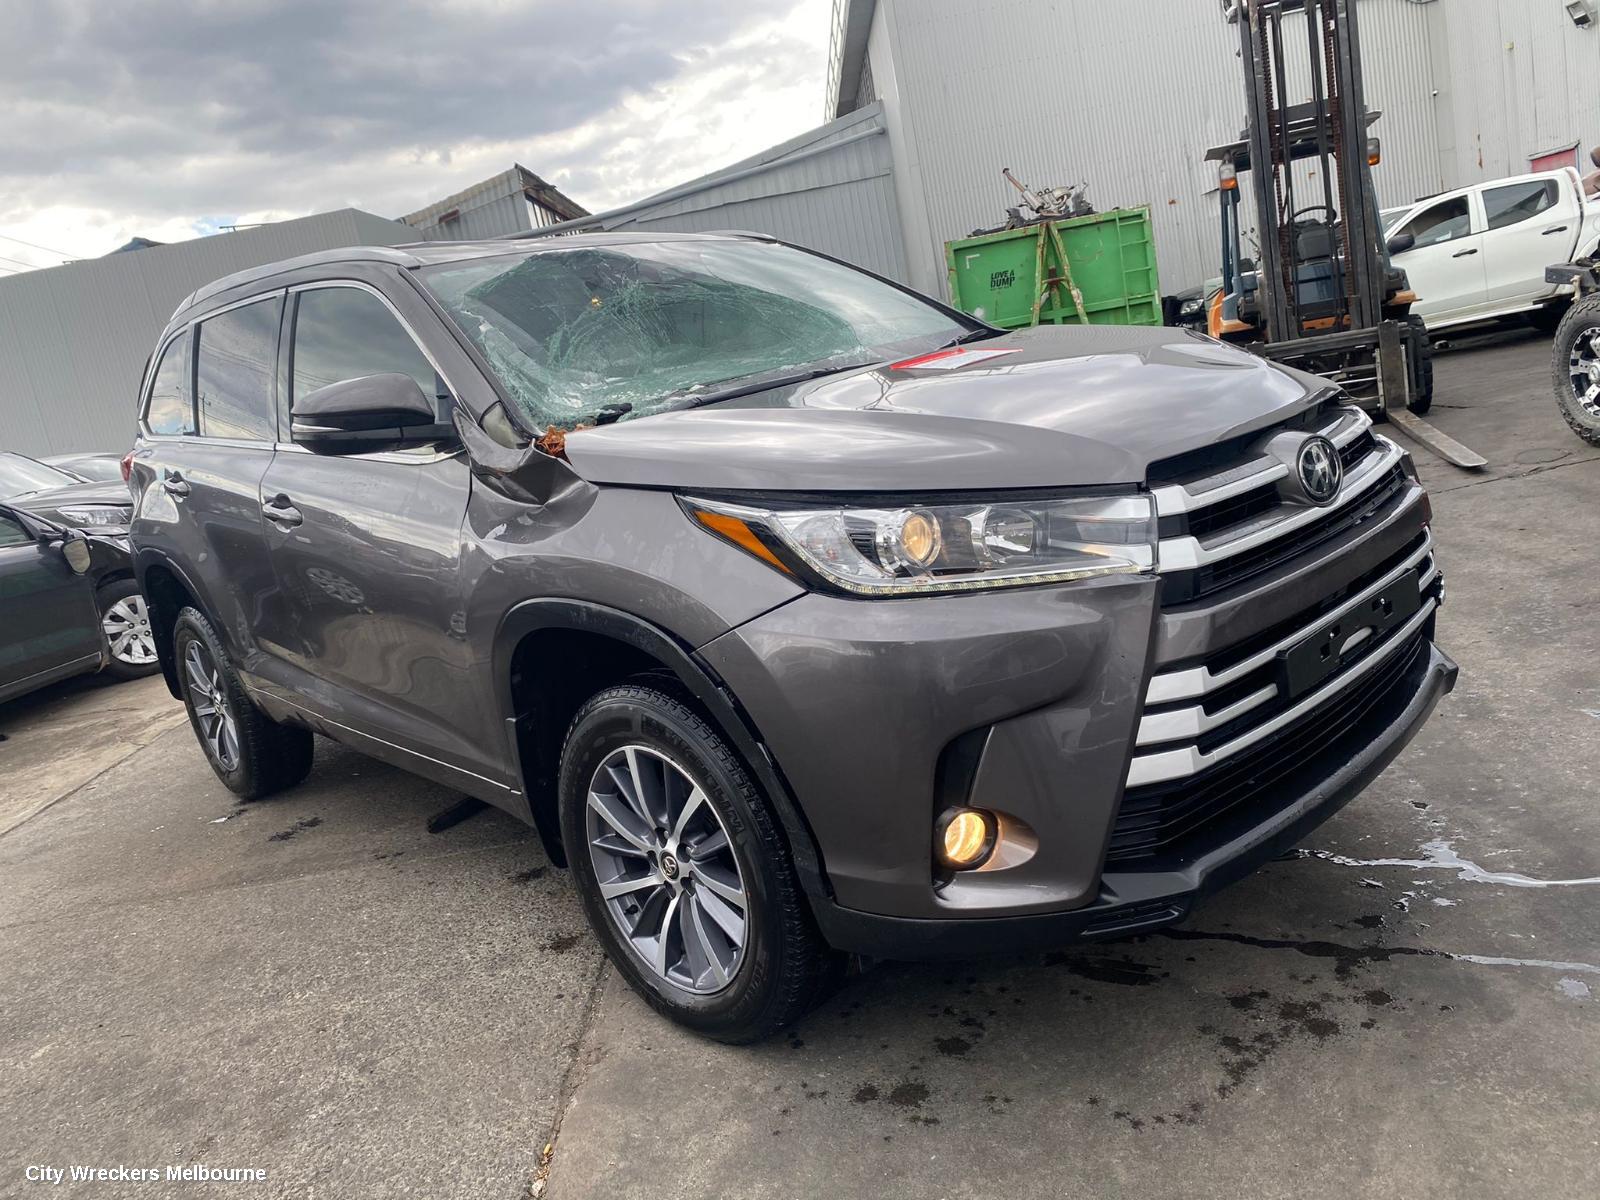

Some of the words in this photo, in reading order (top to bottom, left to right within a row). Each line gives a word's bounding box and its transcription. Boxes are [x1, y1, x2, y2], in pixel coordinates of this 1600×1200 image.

[990, 270, 1009, 280] LOVE
[1009, 269, 1015, 277] A
[990, 276, 1016, 288] DUMP
